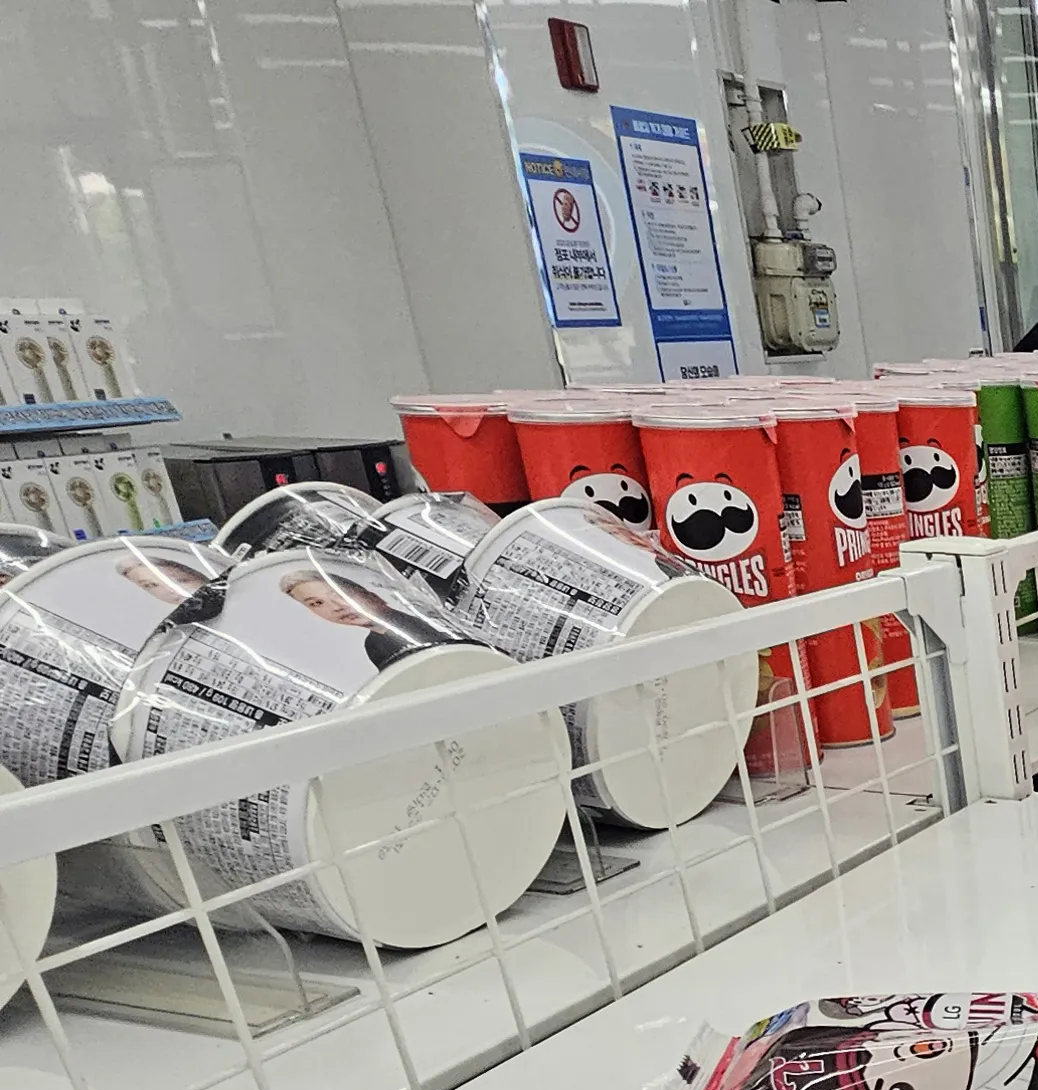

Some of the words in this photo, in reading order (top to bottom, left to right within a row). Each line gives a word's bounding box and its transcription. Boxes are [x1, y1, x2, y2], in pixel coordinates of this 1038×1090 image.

[525, 160, 554, 176] NOTICE
[908, 507, 963, 537] INGLES
[941, 1004, 962, 1021] LG
